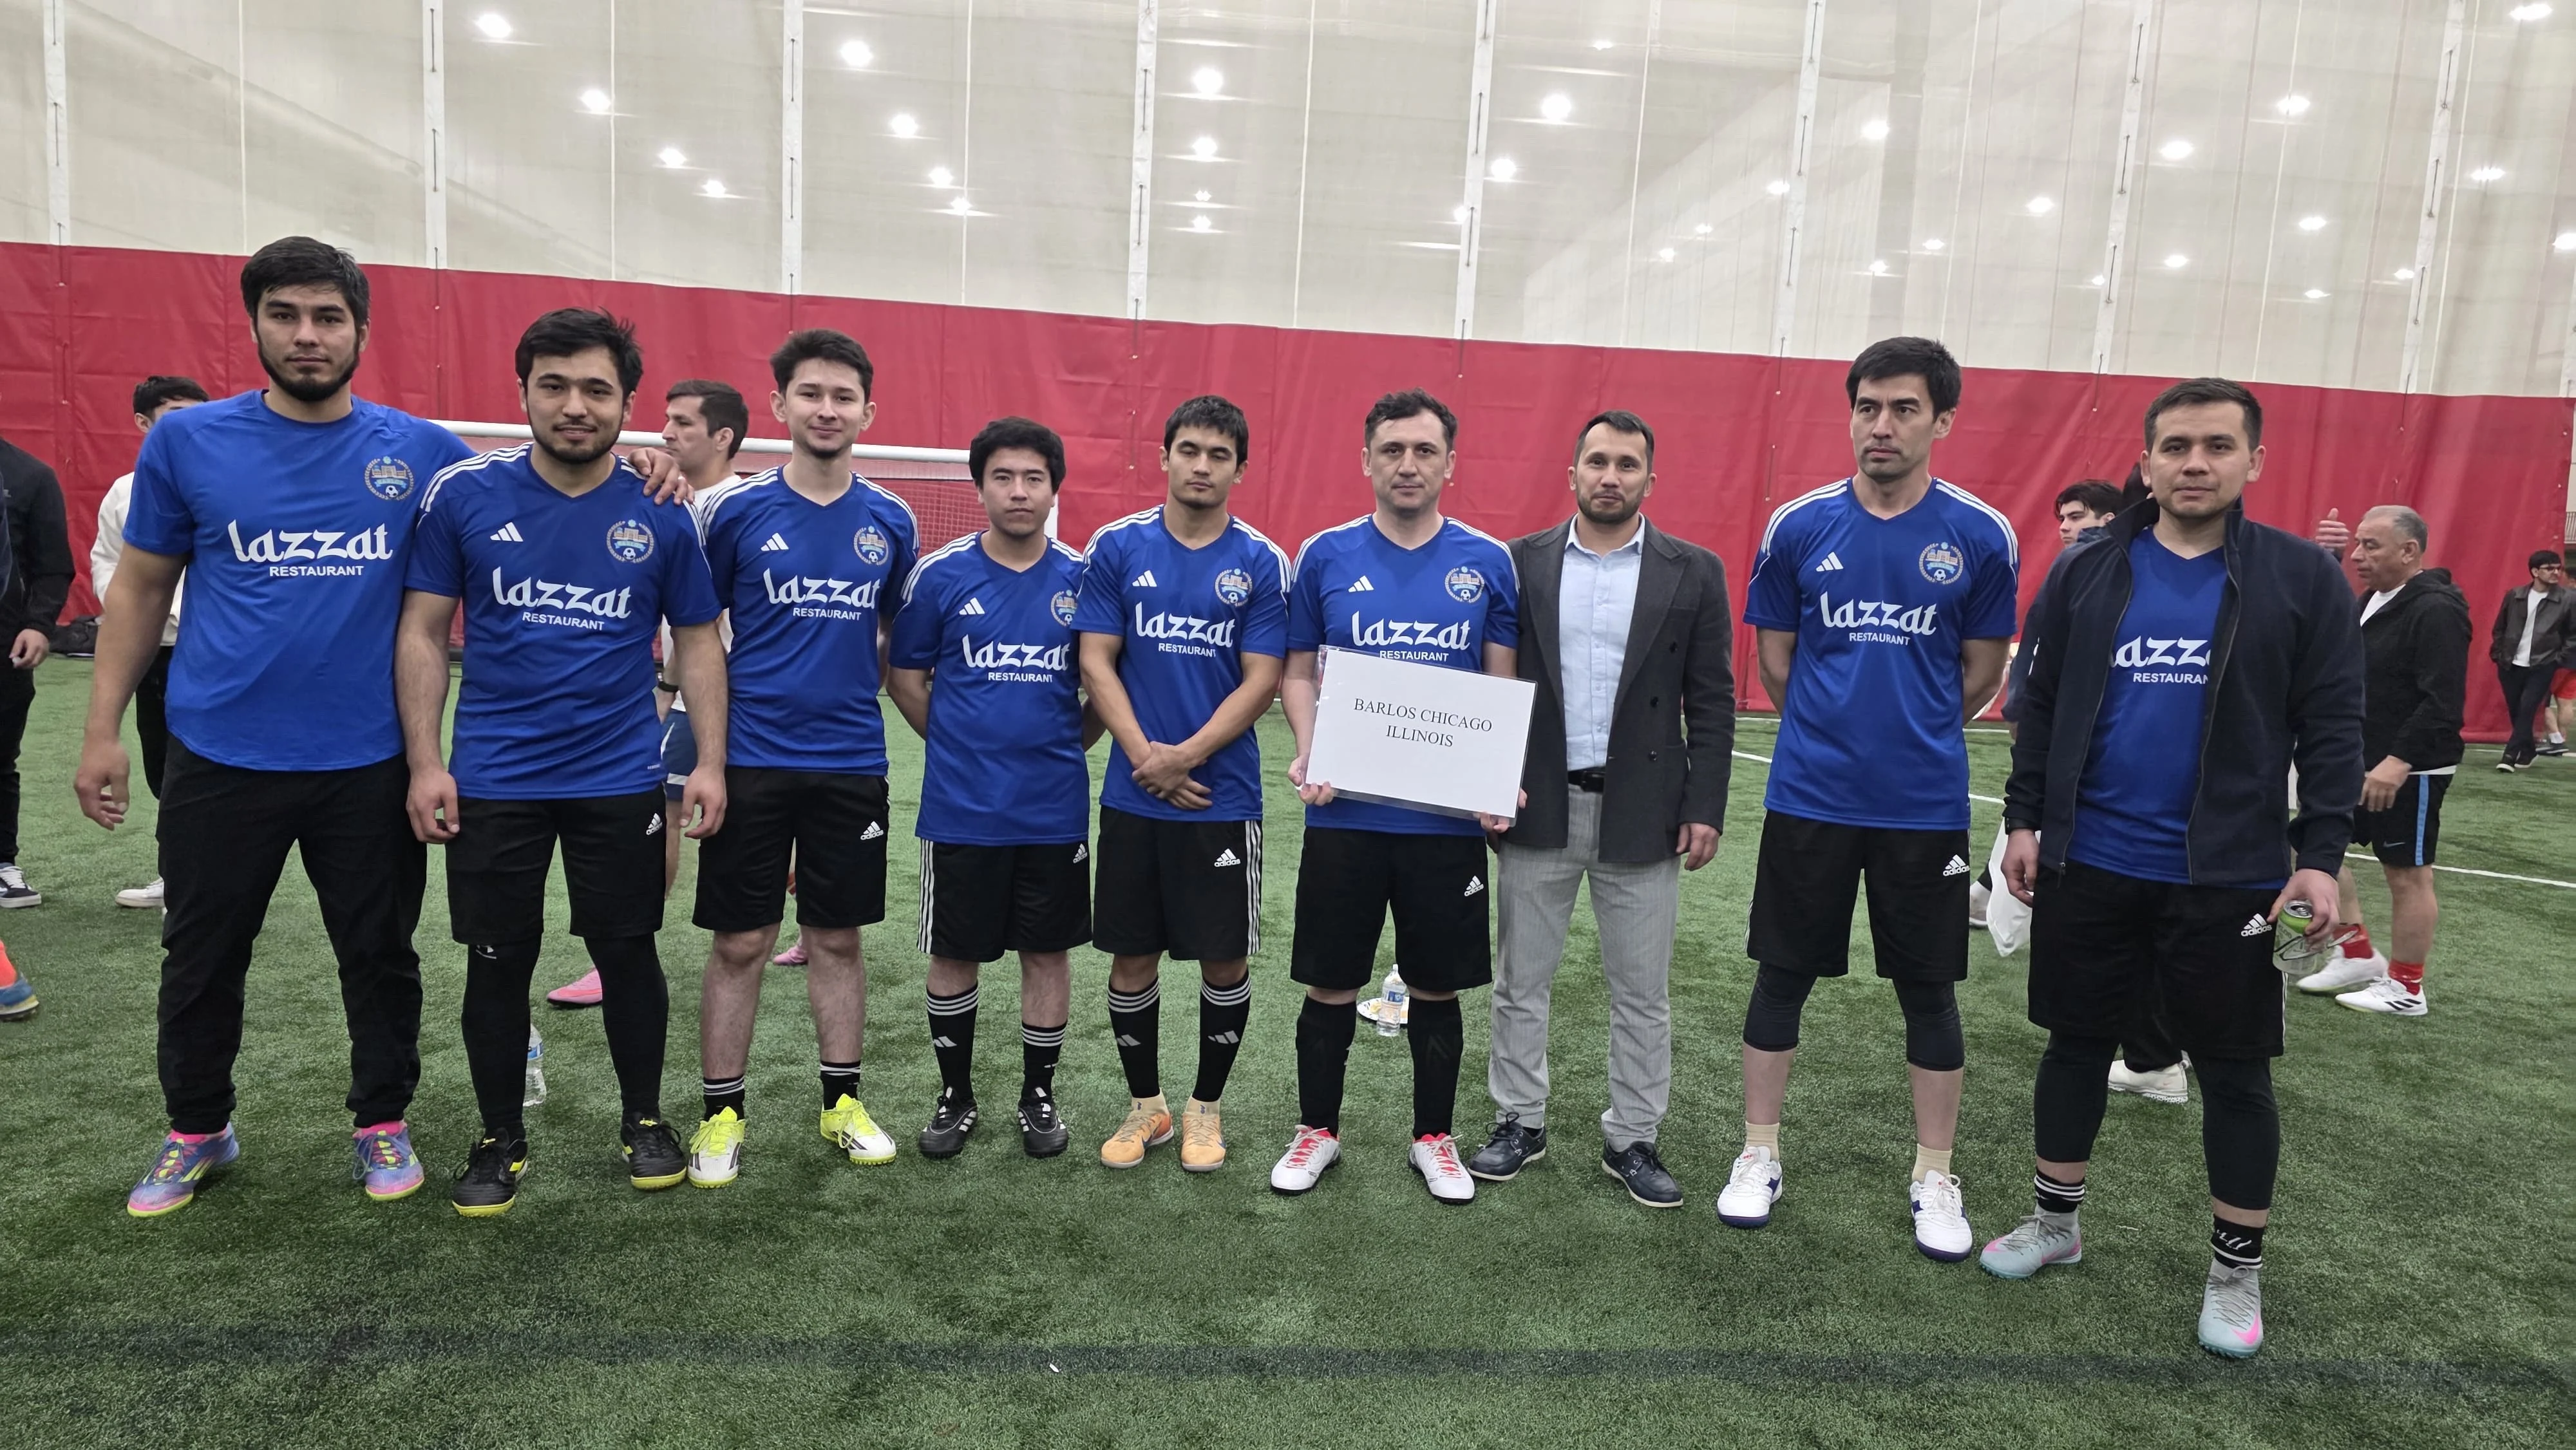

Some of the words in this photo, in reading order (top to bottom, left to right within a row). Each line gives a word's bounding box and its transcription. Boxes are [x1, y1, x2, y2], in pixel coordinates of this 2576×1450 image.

[269, 565, 364, 577] RESTAURANT
[793, 607, 862, 621] RESTAURANT
[522, 612, 605, 630] RESTAURANT
[1849, 632, 1911, 646] RESTAURANT
[1158, 643, 1217, 657] RESTAURANT
[1379, 650, 1449, 662] RESTAURANT
[2109, 636, 2211, 668] azz
[988, 672, 1053, 683] RESTAURANT
[2133, 672, 2208, 684] RESTAURAN
[1354, 699, 1416, 719] BARLOS
[1421, 710, 1492, 731] CHICAGO
[1386, 726, 1454, 747] ILLINOIS
[860, 829, 884, 840] adidas
[1214, 858, 1241, 867] adidas
[1942, 865, 1971, 876] adidas
[1464, 883, 1484, 897] adidas
[2240, 924, 2273, 937] adidas
